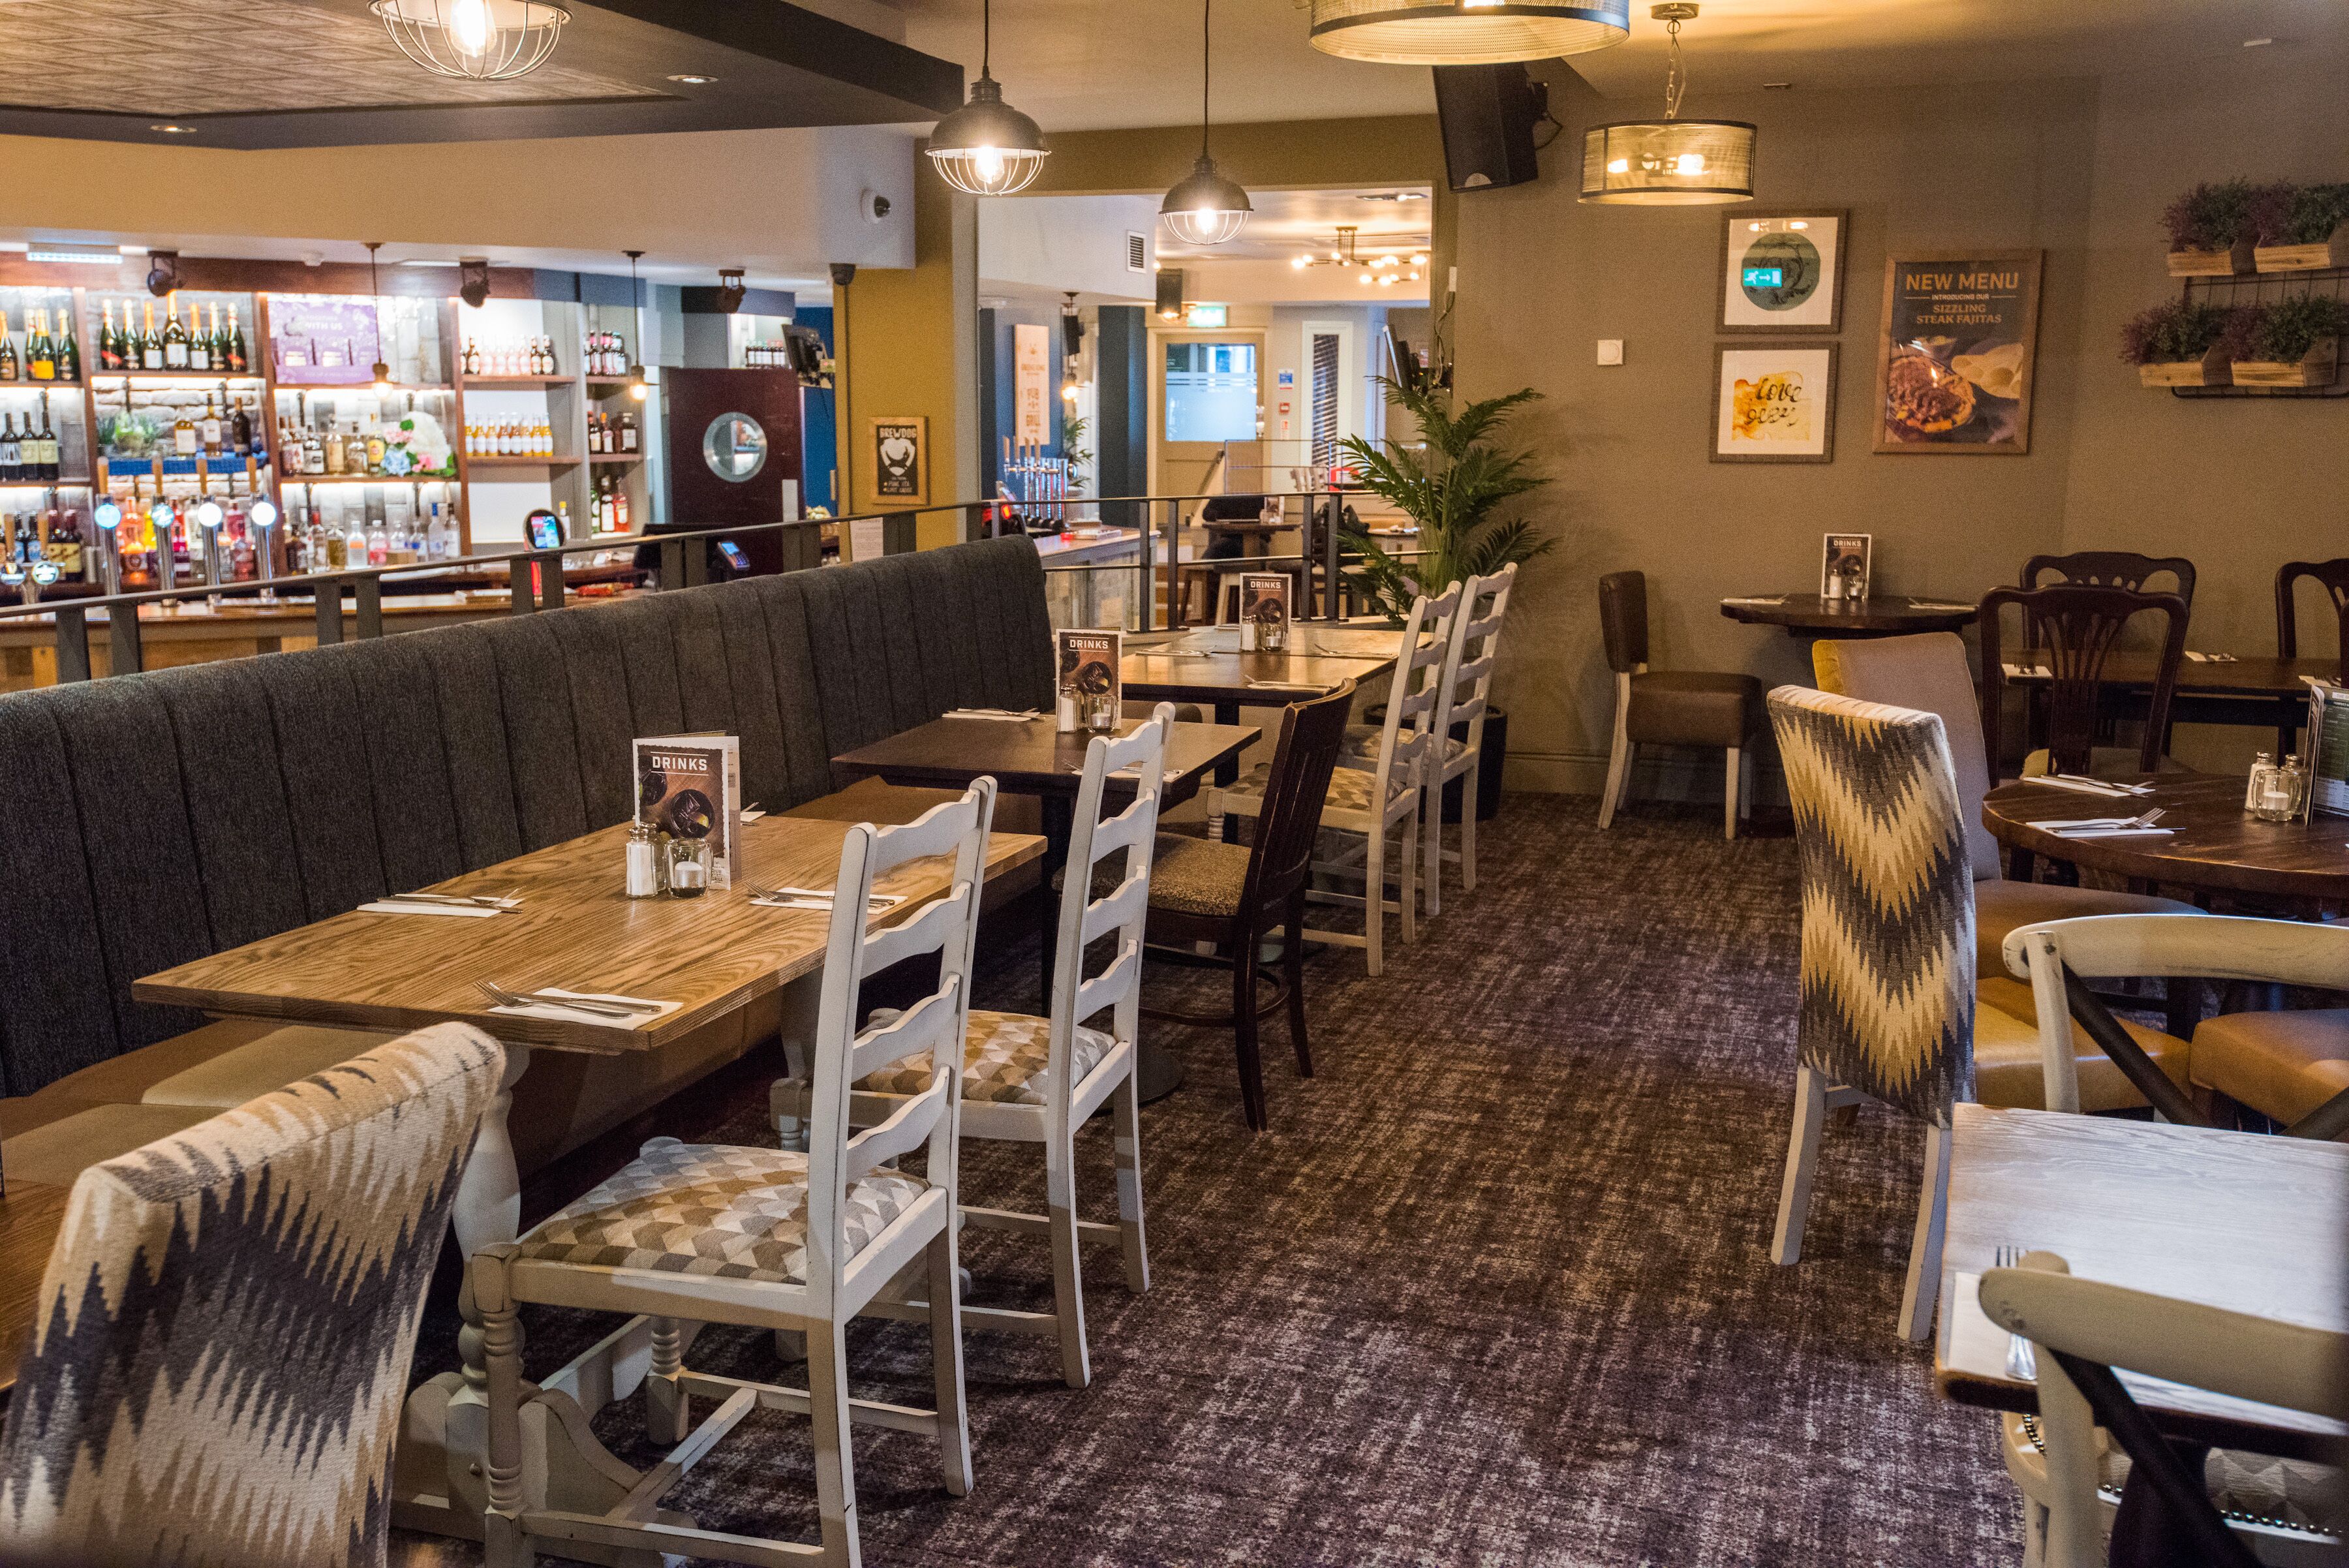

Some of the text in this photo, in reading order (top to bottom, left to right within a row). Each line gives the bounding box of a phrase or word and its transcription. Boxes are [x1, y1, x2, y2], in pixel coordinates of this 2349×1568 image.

[1906, 272, 2019, 291] NEW MENU
[1933, 304, 1986, 313] SIZZLING
[1916, 314, 2002, 325] STEAK FAJITAS
[879, 427, 917, 438] BREWDOG
[1069, 639, 1109, 650] DRINKS
[652, 756, 708, 771] DRINKS
